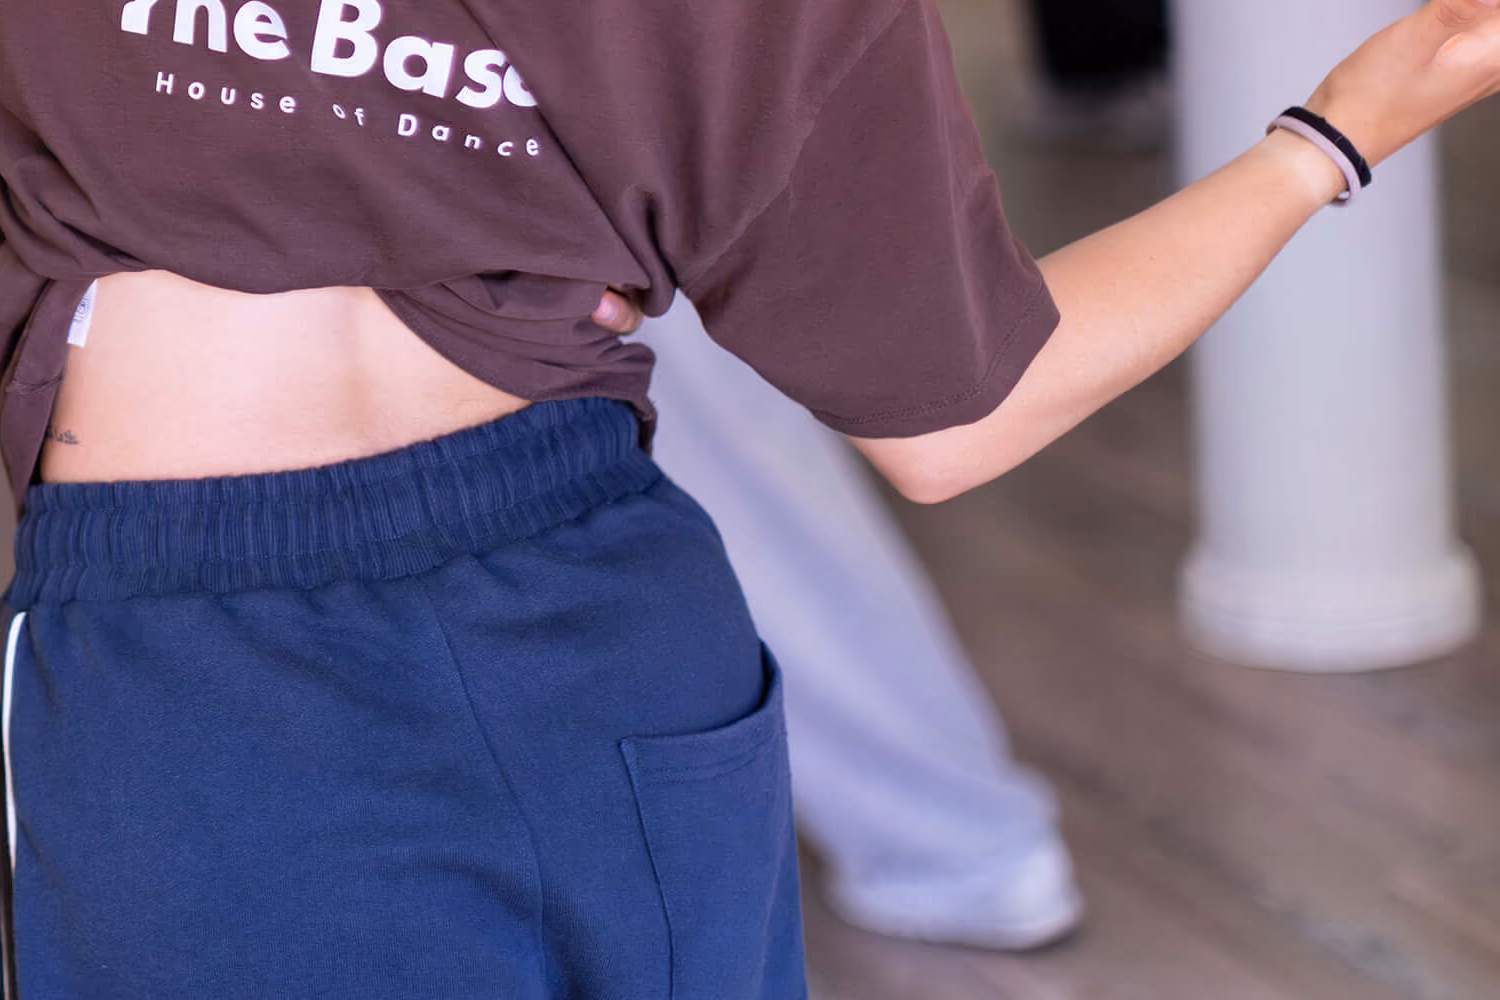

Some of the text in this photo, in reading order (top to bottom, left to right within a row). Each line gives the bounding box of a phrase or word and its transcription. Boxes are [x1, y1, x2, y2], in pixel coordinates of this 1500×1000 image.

[155, 71, 541, 157] House of Dance
